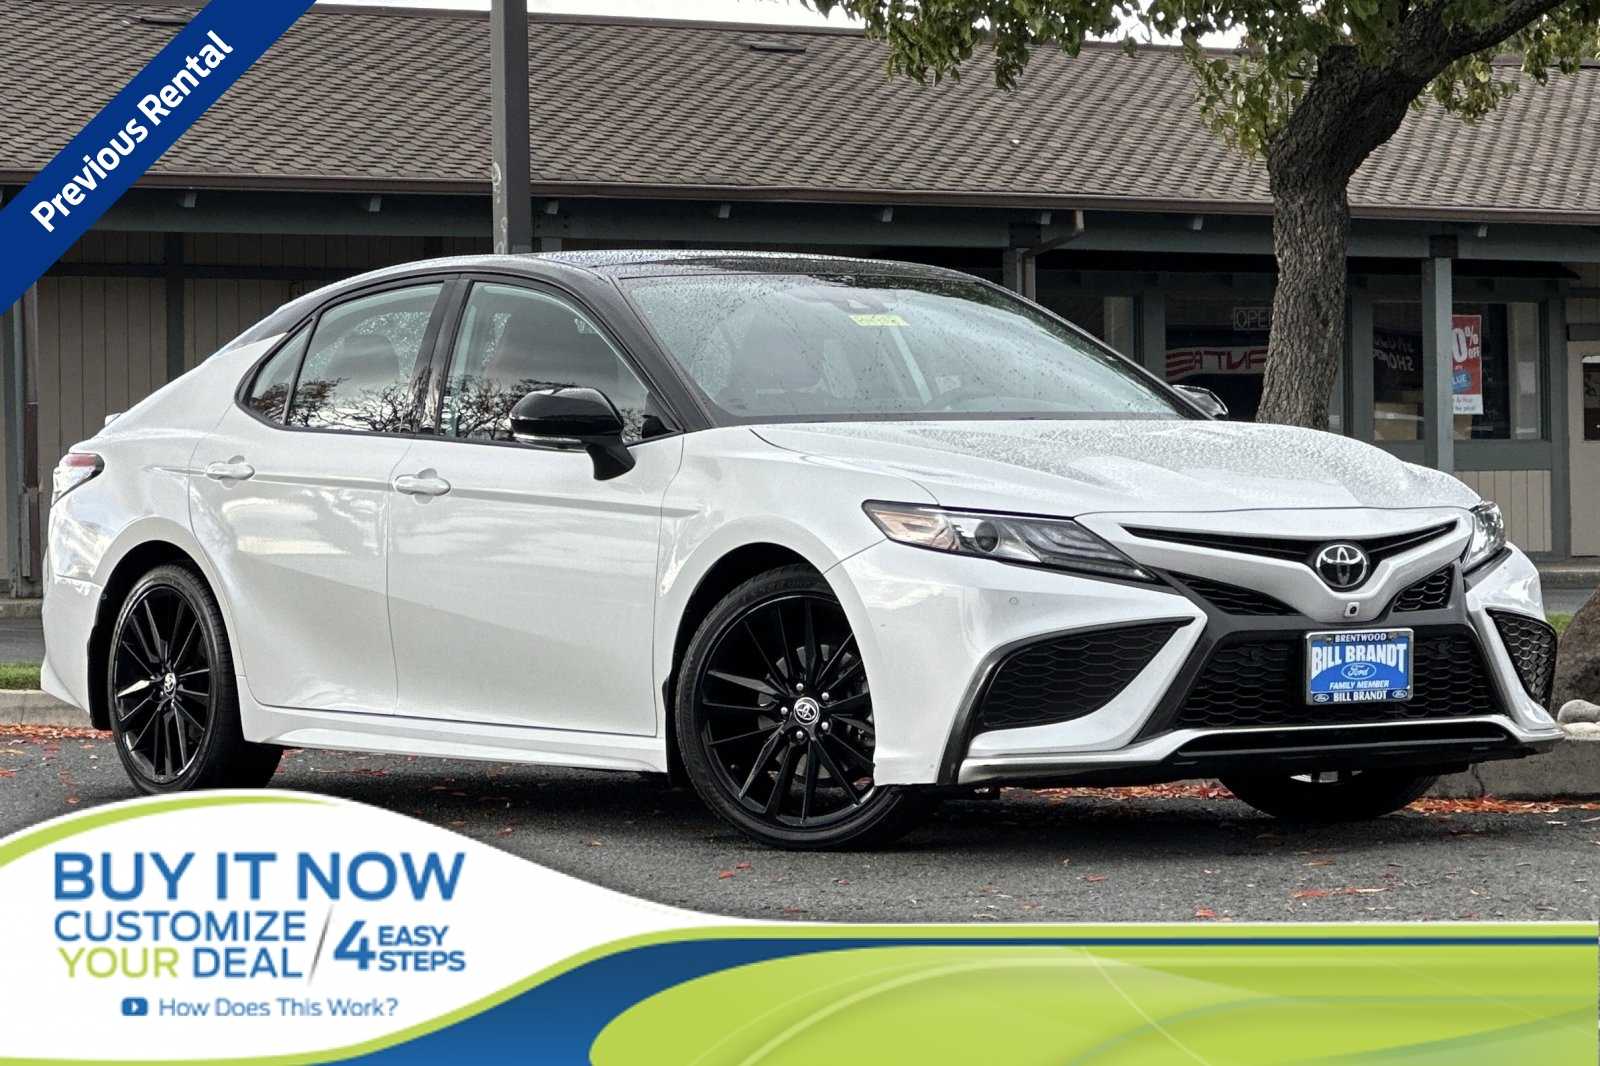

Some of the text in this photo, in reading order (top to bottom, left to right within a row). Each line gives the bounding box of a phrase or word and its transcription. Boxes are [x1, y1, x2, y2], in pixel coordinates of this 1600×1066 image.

[1236, 310, 1271, 328] OPE
[1335, 633, 1387, 643] BRENTWOOD
[1311, 643, 1408, 680] BILL BRANDT
[1329, 680, 1390, 691] FAMILY MEMBER
[1333, 690, 1388, 702] BILL BRANDT
